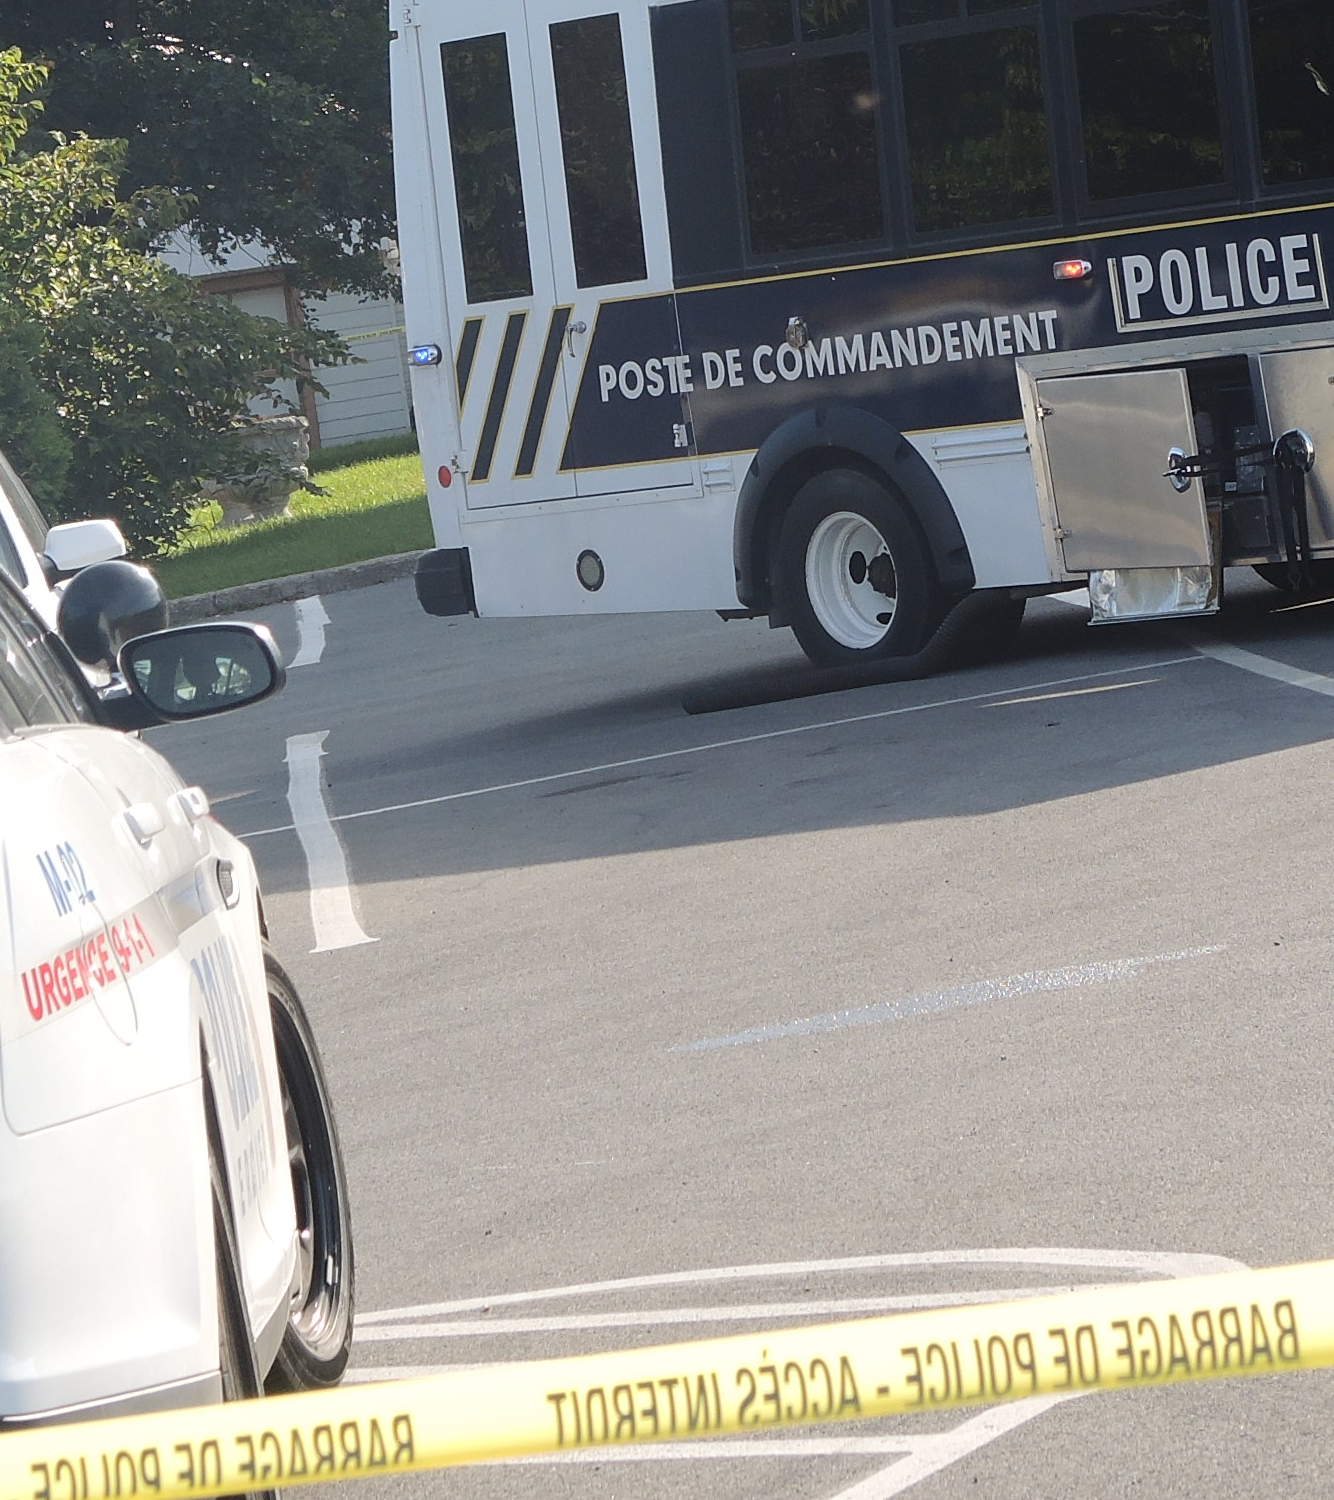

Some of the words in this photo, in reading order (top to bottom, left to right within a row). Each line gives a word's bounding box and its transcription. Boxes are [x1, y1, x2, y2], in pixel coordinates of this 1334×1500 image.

[1121, 234, 1316, 319] POLICE
[598, 355, 695, 402] POSTE
[703, 348, 744, 389] DE
[752, 309, 1058, 384] COMMANDEMENT
[21, 932, 117, 1021] URGENCE
